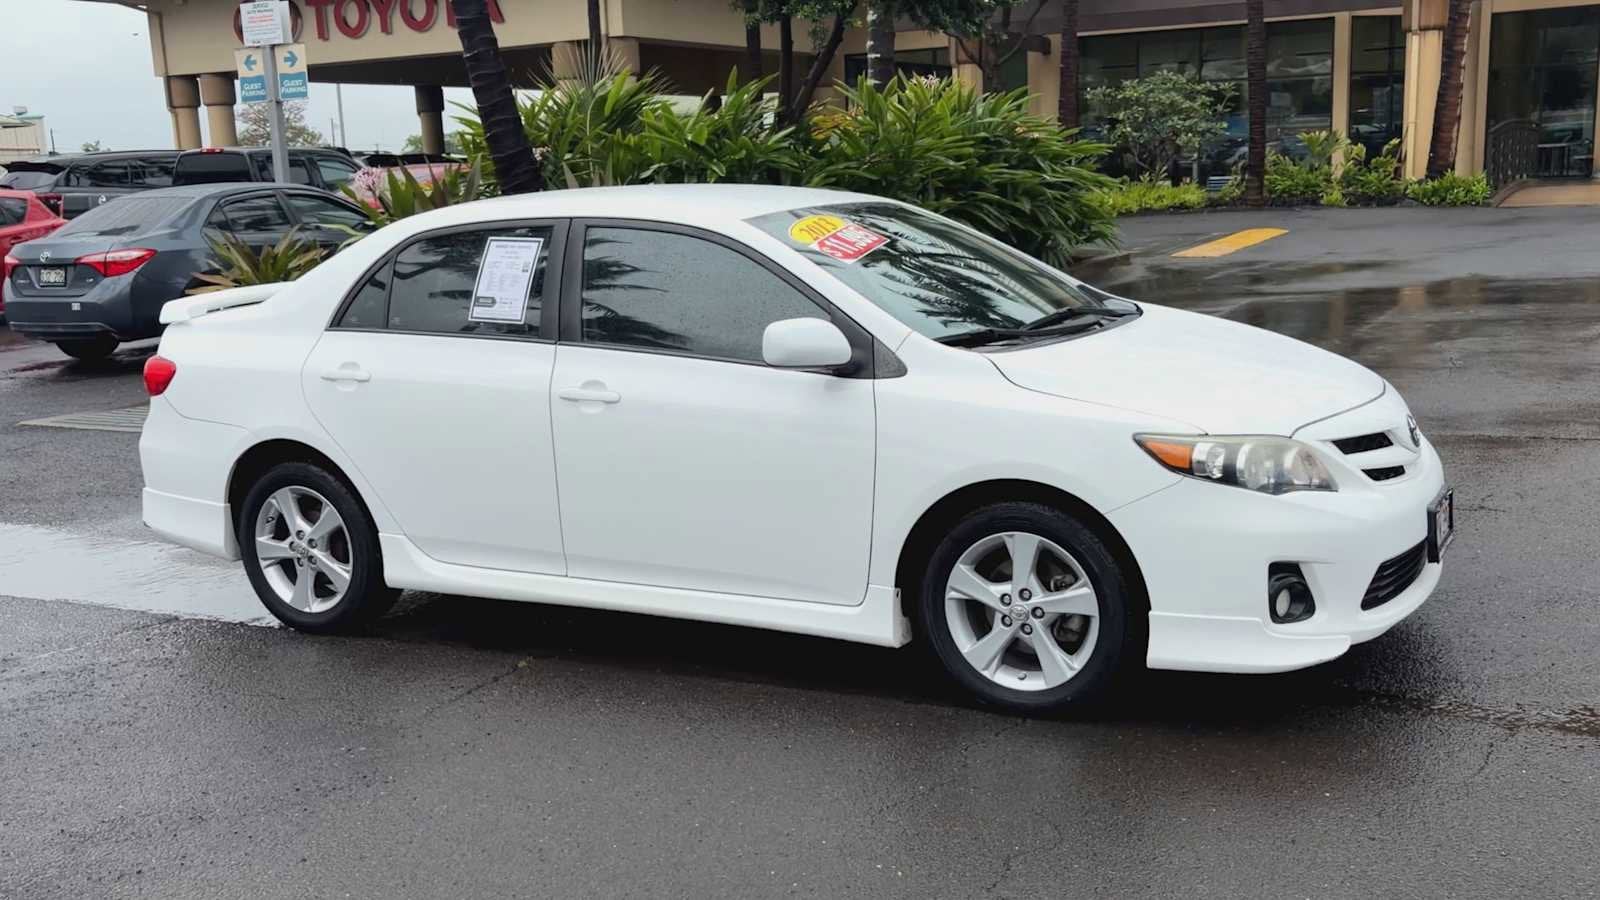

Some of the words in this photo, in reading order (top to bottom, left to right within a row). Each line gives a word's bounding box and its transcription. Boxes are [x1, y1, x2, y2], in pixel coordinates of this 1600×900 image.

[243, 82, 262, 90] GUEST
[242, 89, 266, 97] PARKING
[281, 86, 307, 95] PARKING
[799, 217, 838, 241] 2013
